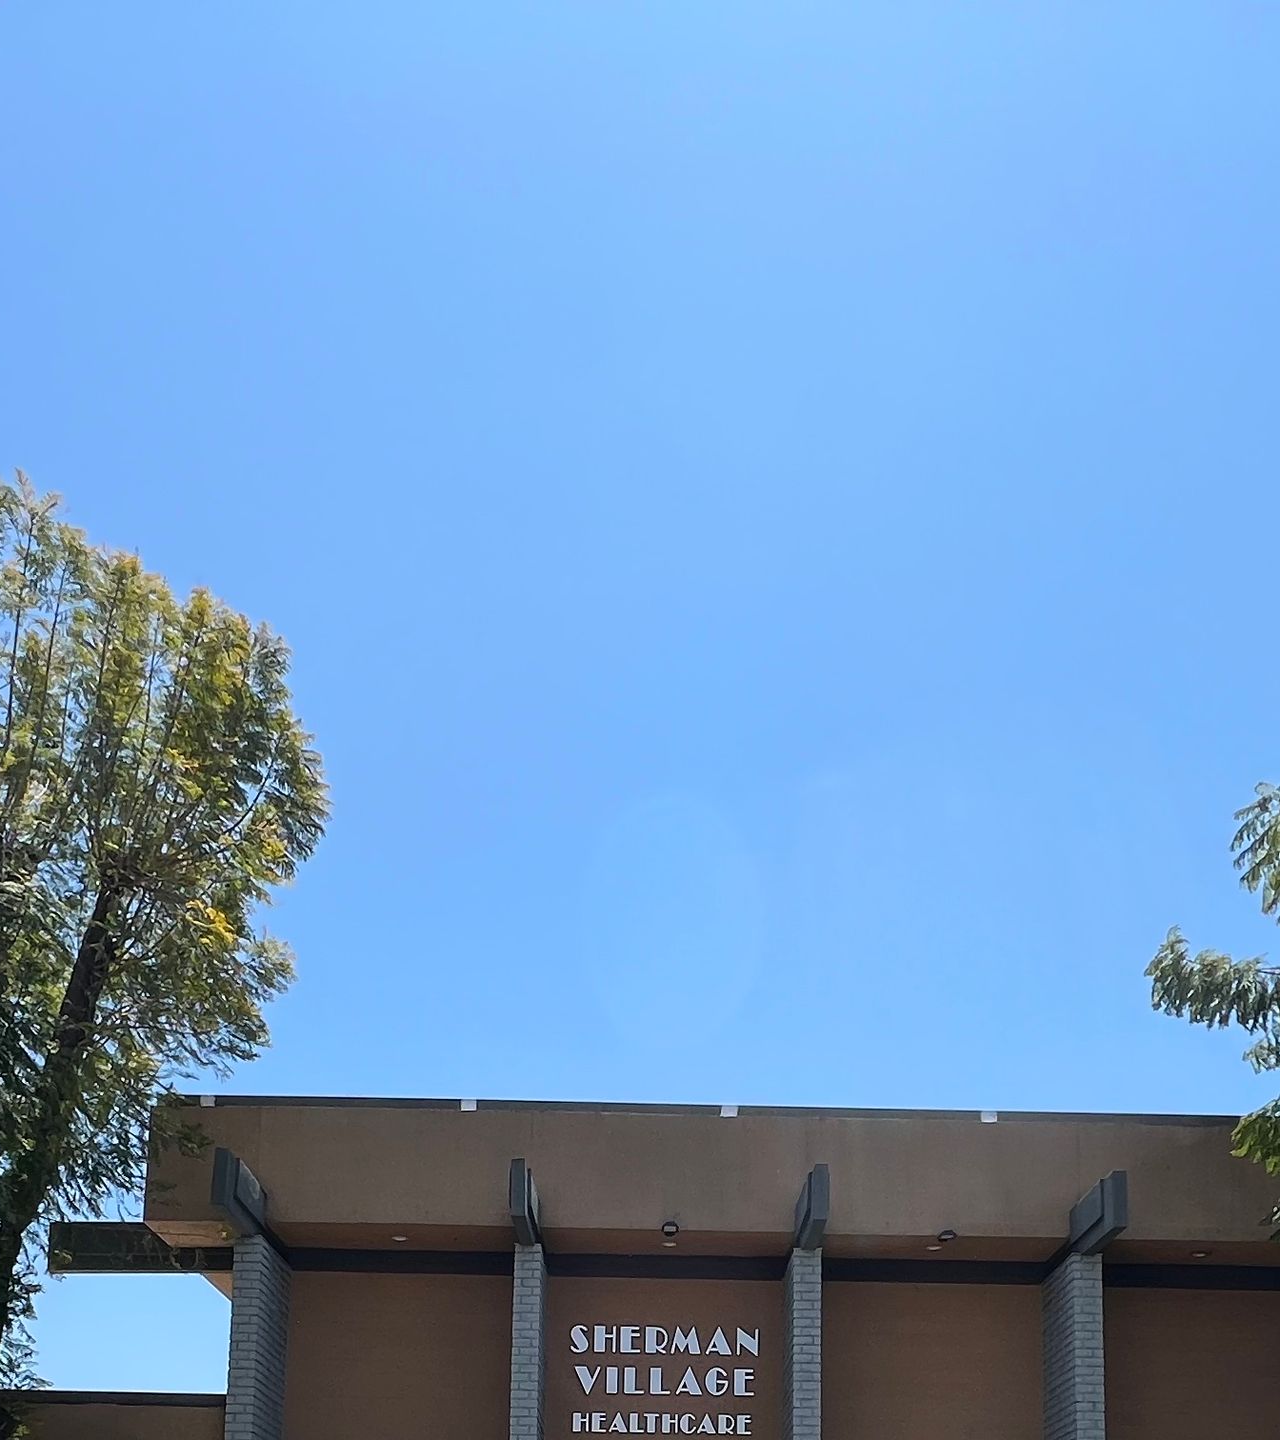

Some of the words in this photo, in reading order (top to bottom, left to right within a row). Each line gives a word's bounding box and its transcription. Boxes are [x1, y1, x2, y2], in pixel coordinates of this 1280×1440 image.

[569, 1324, 760, 1357] SHERMAN
[574, 1365, 755, 1397] VILLAGE
[571, 1411, 753, 1436] HEALTHCARE
